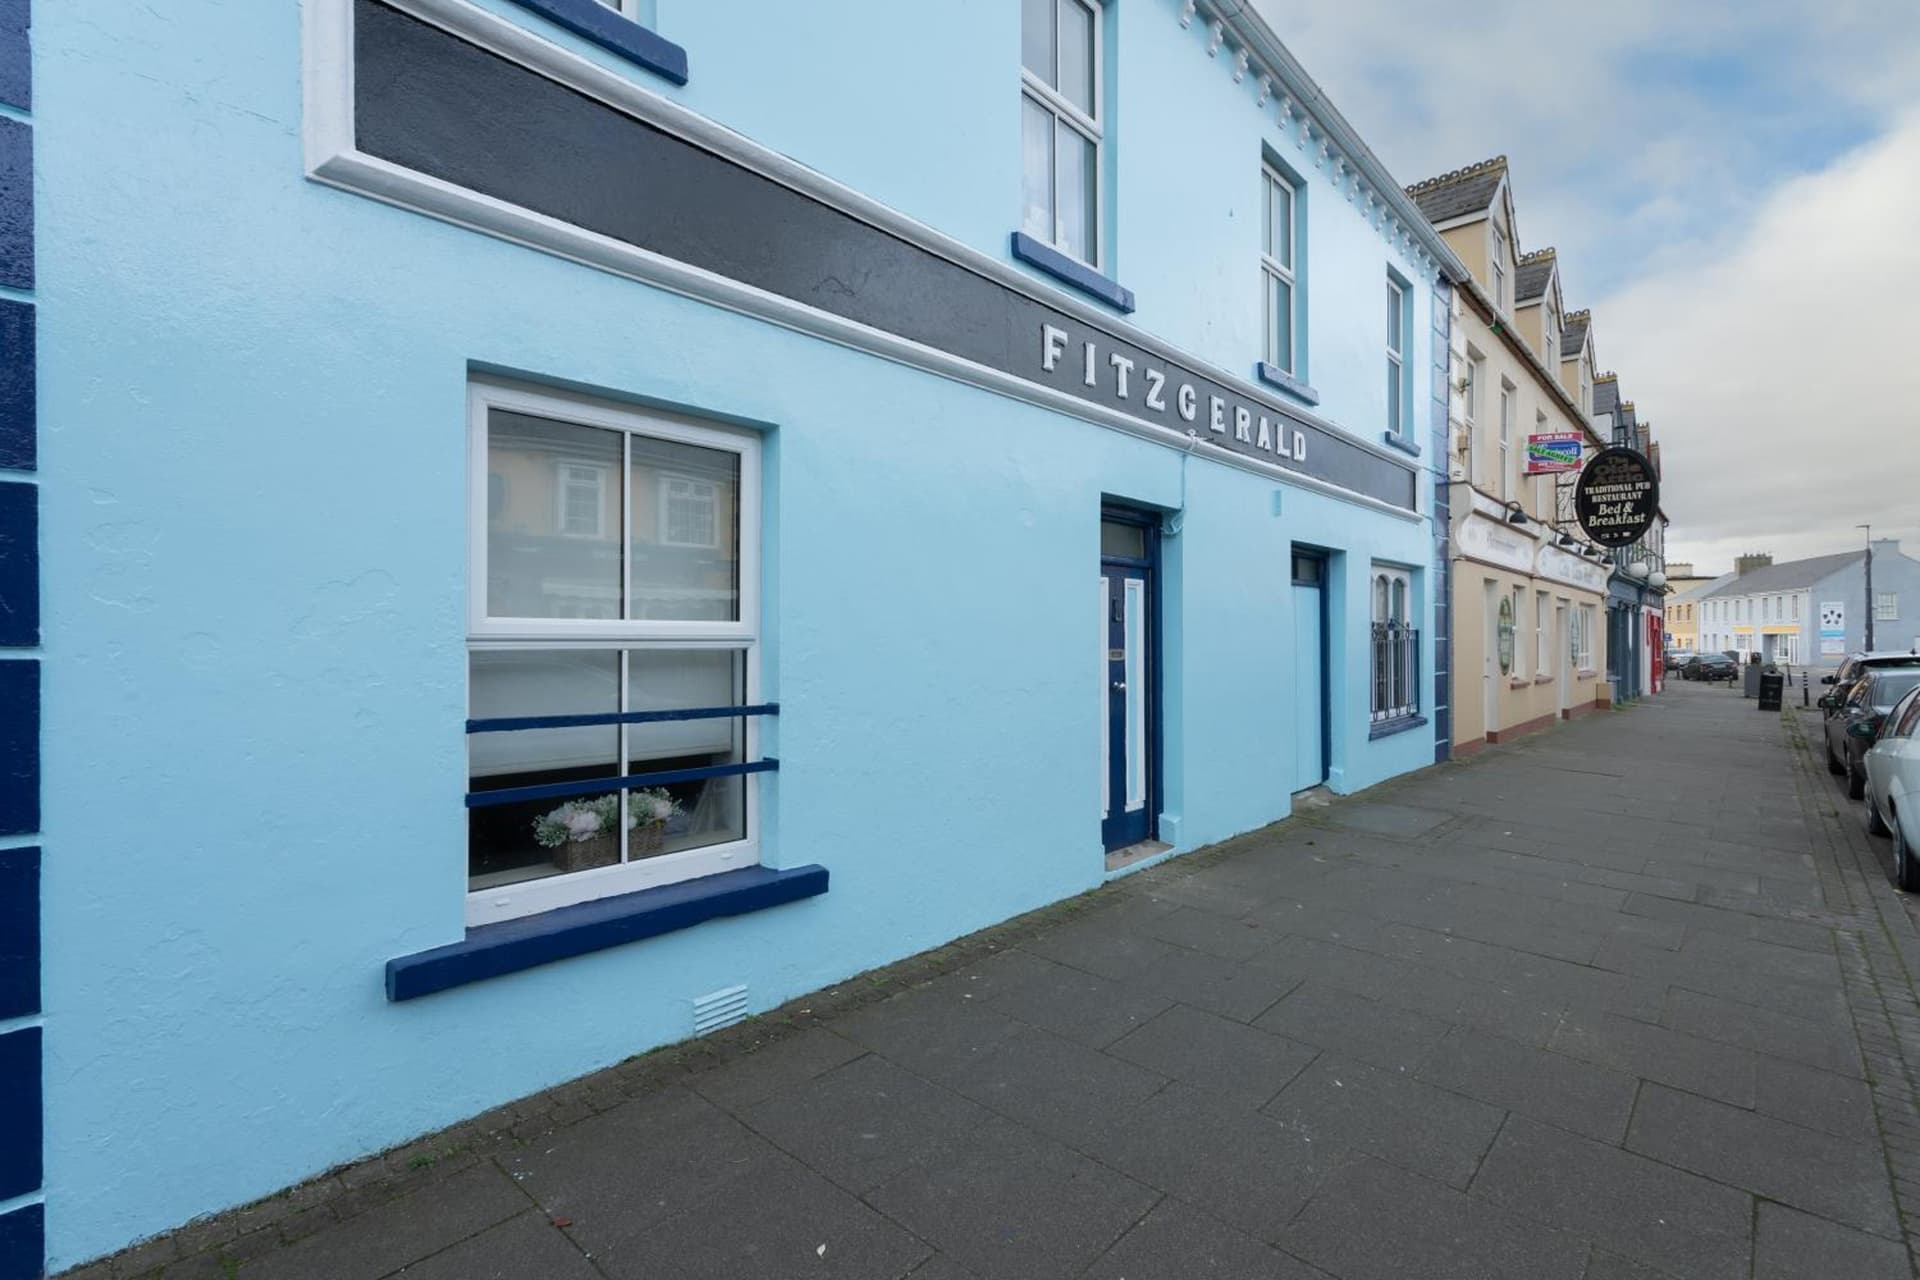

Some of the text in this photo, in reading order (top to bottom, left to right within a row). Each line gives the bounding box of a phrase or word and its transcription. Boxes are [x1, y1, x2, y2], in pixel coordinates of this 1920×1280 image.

[1042, 323, 1307, 462] FITZGERALD
[1584, 482, 1651, 495] TRADITIONAL PUB
[1591, 491, 1643, 503] RESTAURANT
[1598, 501, 1634, 515] Bed &
[1588, 512, 1646, 527] Breakfast
